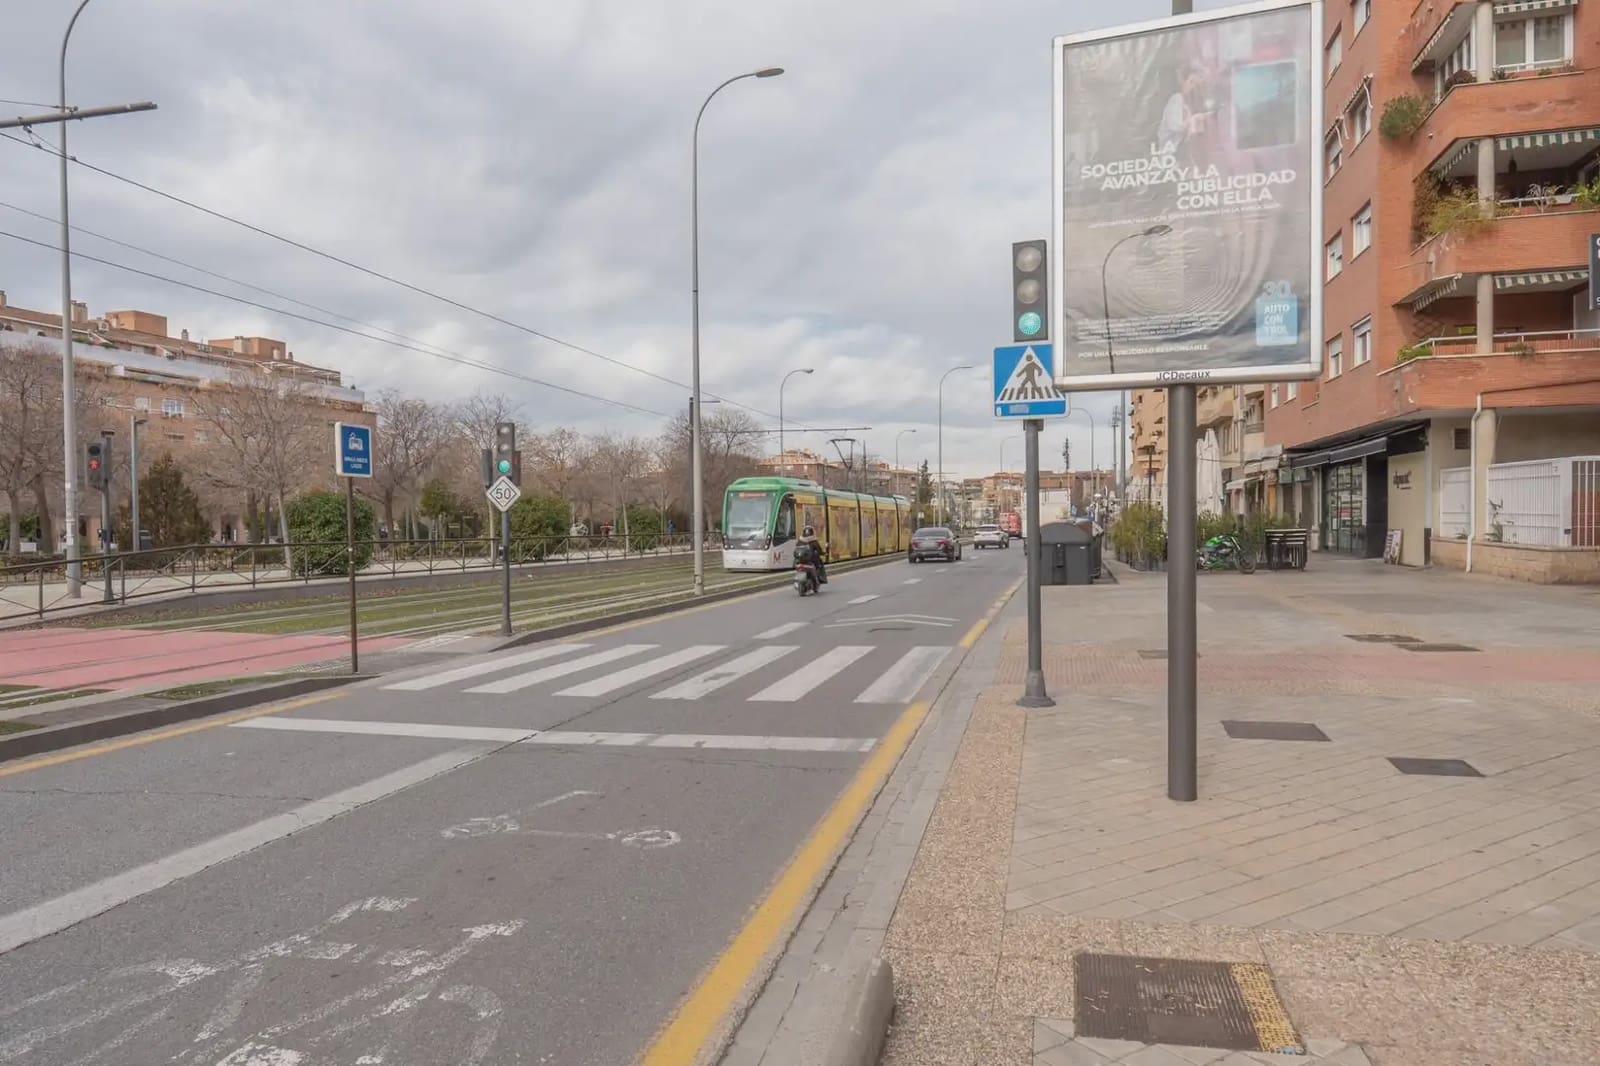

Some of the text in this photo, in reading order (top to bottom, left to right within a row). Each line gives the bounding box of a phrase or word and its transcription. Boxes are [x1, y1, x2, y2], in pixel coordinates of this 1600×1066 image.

[1151, 141, 1177, 155] LA
[1081, 155, 1177, 179] SOCIEDAD
[1175, 164, 1219, 182] Y LA
[1101, 168, 1177, 191] AVANZA
[1177, 169, 1297, 195] PUBLICIDAD
[1176, 187, 1273, 210] CON ELLA
[1156, 371, 1210, 381] JCDecaux
[495, 488, 511, 500] 50
